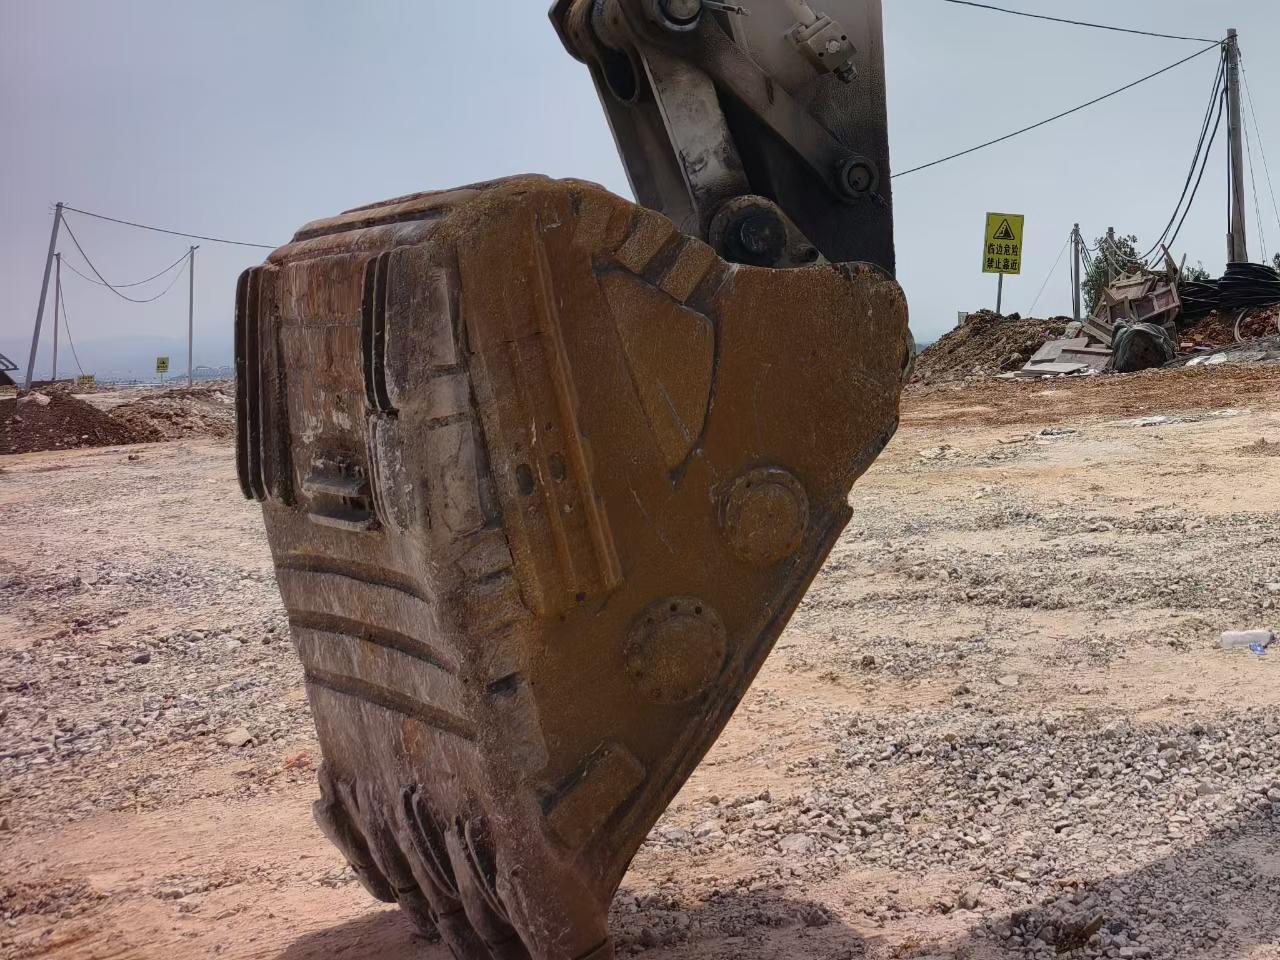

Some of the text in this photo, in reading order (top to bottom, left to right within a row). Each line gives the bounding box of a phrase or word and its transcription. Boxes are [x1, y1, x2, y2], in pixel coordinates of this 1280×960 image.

[987, 243, 1019, 256] 临边危险
[986, 258, 1018, 271] 禁止靠近
